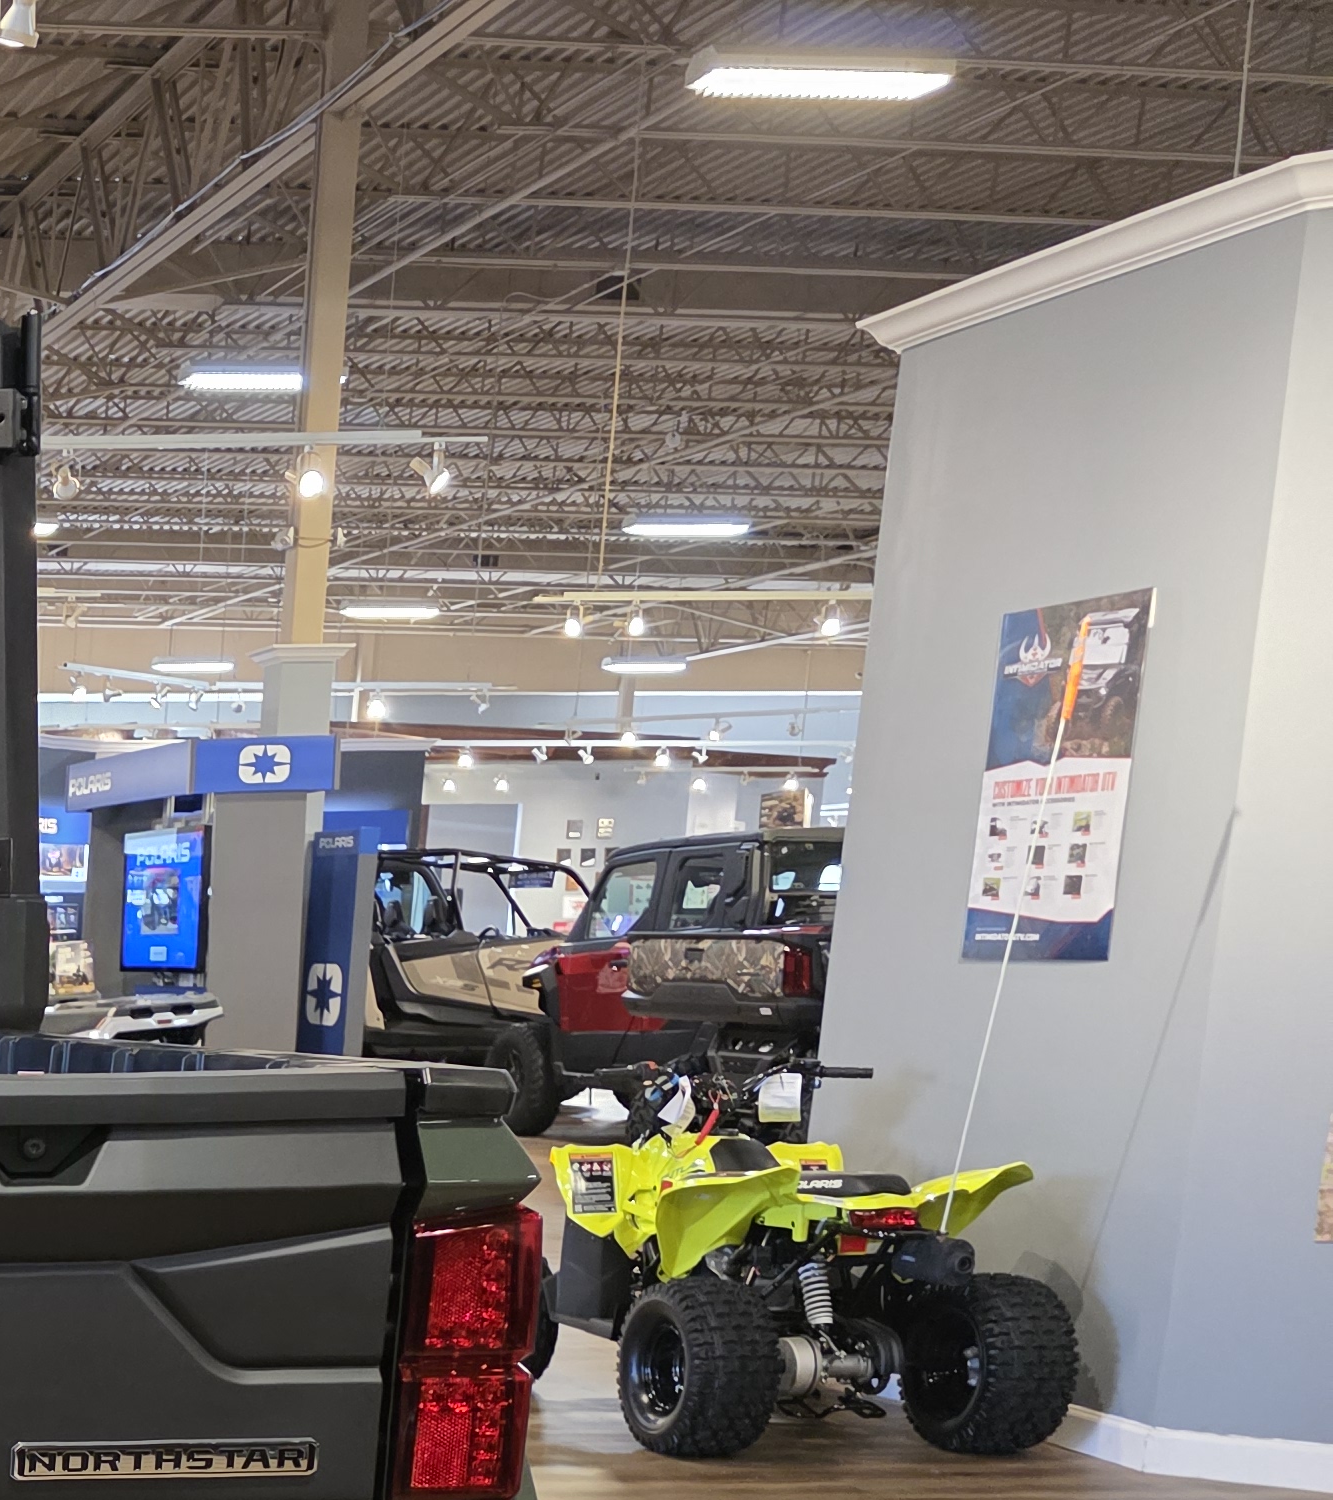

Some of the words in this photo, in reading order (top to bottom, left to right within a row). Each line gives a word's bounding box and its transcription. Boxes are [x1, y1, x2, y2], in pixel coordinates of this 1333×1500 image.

[69, 771, 112, 797] POLARIS
[136, 841, 191, 867] POLARIS
[318, 835, 354, 849] POLARIS
[797, 1178, 843, 1190] OLARIS
[26, 1447, 304, 1473] NORTHSTAR
